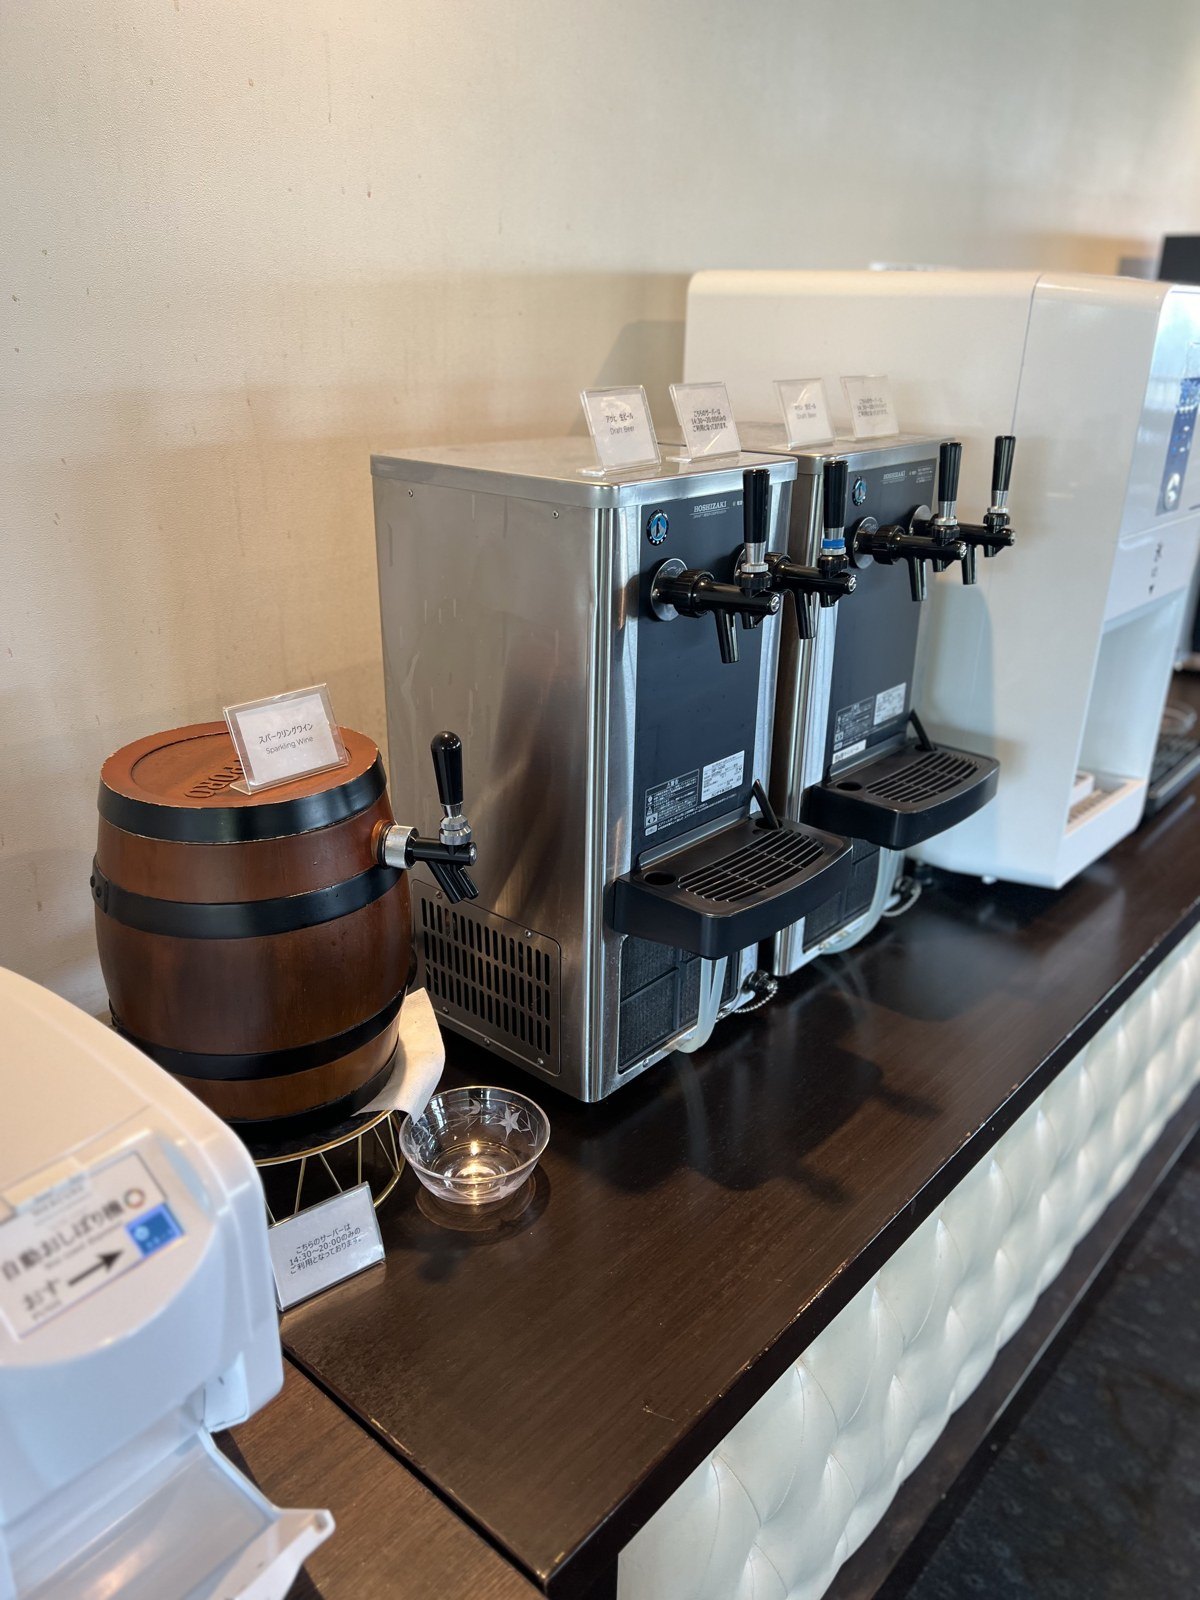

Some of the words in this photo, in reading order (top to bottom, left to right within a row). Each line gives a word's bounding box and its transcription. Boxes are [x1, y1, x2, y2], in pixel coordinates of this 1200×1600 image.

[693, 500, 727, 513] HOSHIZAKI
[259, 724, 313, 744] スパークリングワイン
[265, 742, 296, 754] Sparkling
[296, 737, 313, 745] Wine
[296, 1223, 351, 1254] こちらのサーバーは
[290, 1236, 362, 1275] ご利用となっております。
